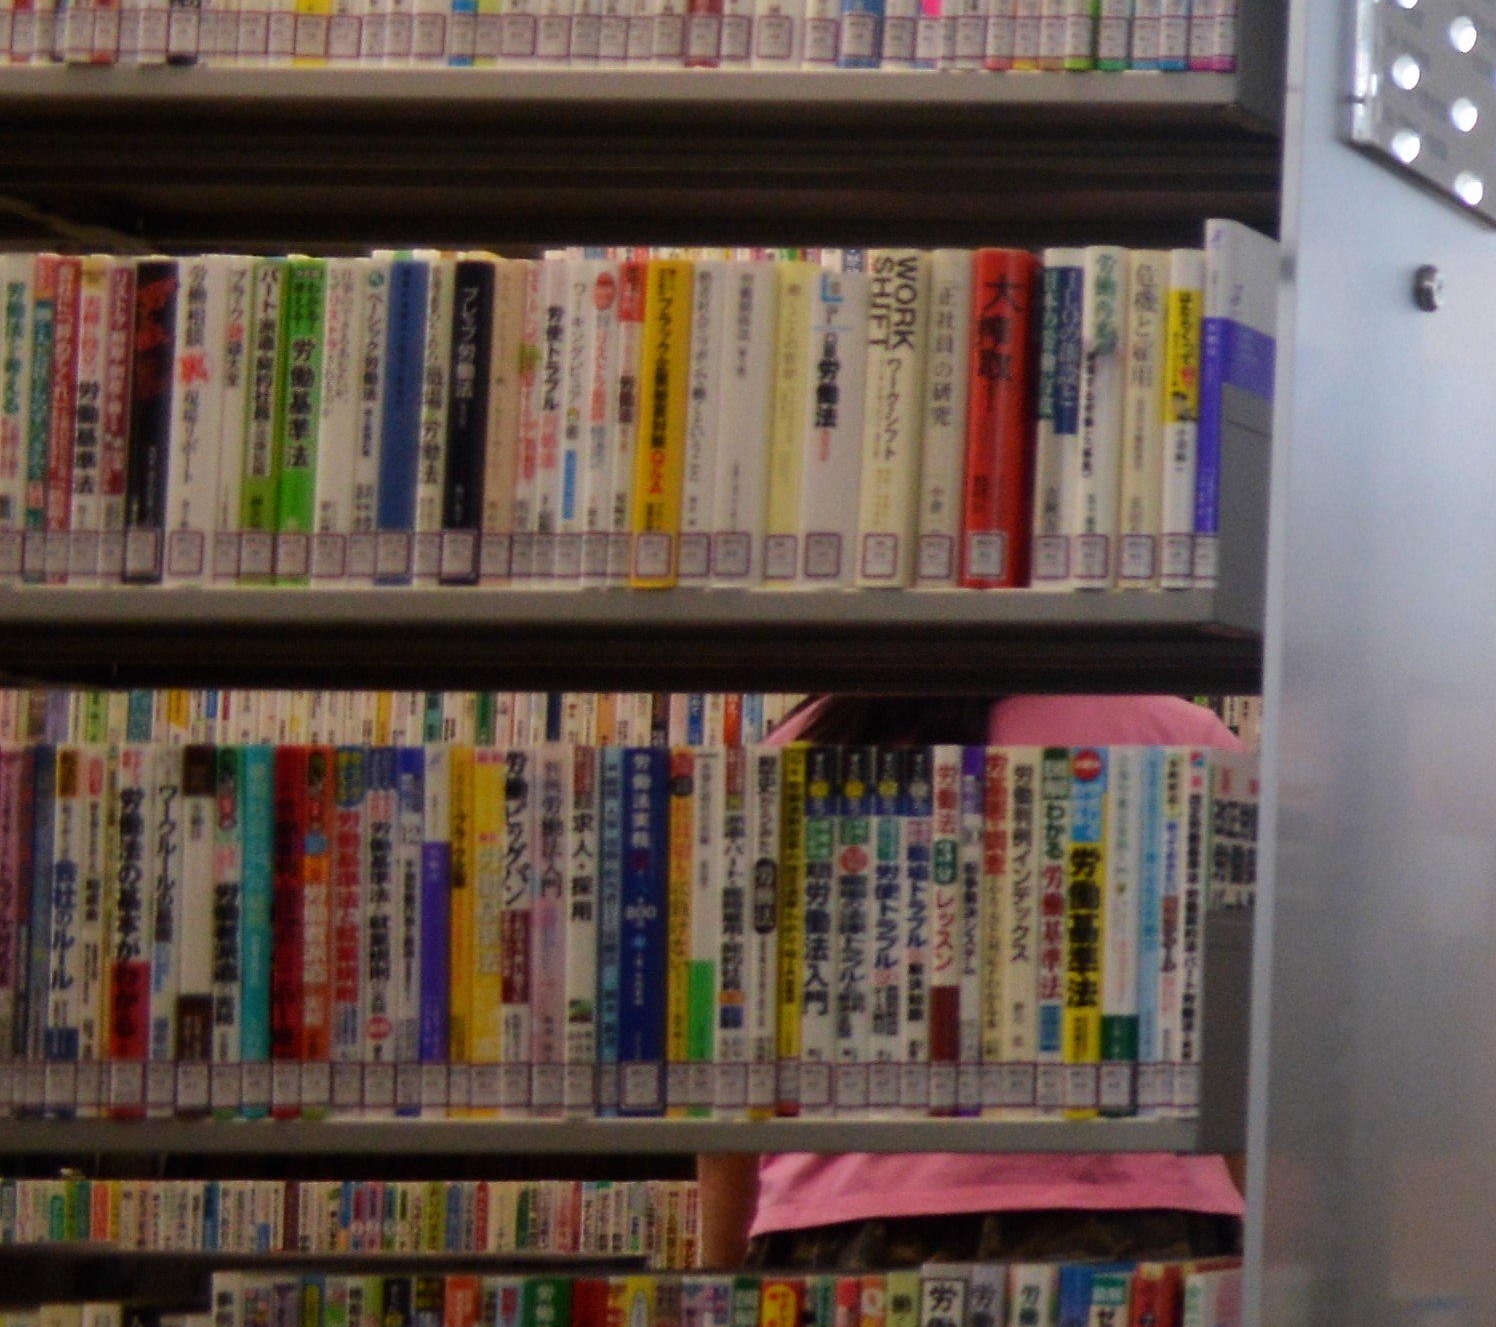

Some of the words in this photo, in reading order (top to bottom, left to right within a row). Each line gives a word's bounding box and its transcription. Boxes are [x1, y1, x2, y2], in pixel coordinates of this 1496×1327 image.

[872, 256, 896, 348] SHIFT
[894, 256, 918, 352] WORK
[73, 380, 101, 496] 労働基準法
[286, 336, 316, 469] 労働基準法
[504, 752, 532, 911] 労働ビッグバン
[934, 758, 958, 834] 労働法
[1044, 801, 1064, 859] わかる
[570, 813, 595, 923] 求人・採用
[934, 880, 958, 972] レッスン
[1066, 845, 1100, 1010] 労働基準法
